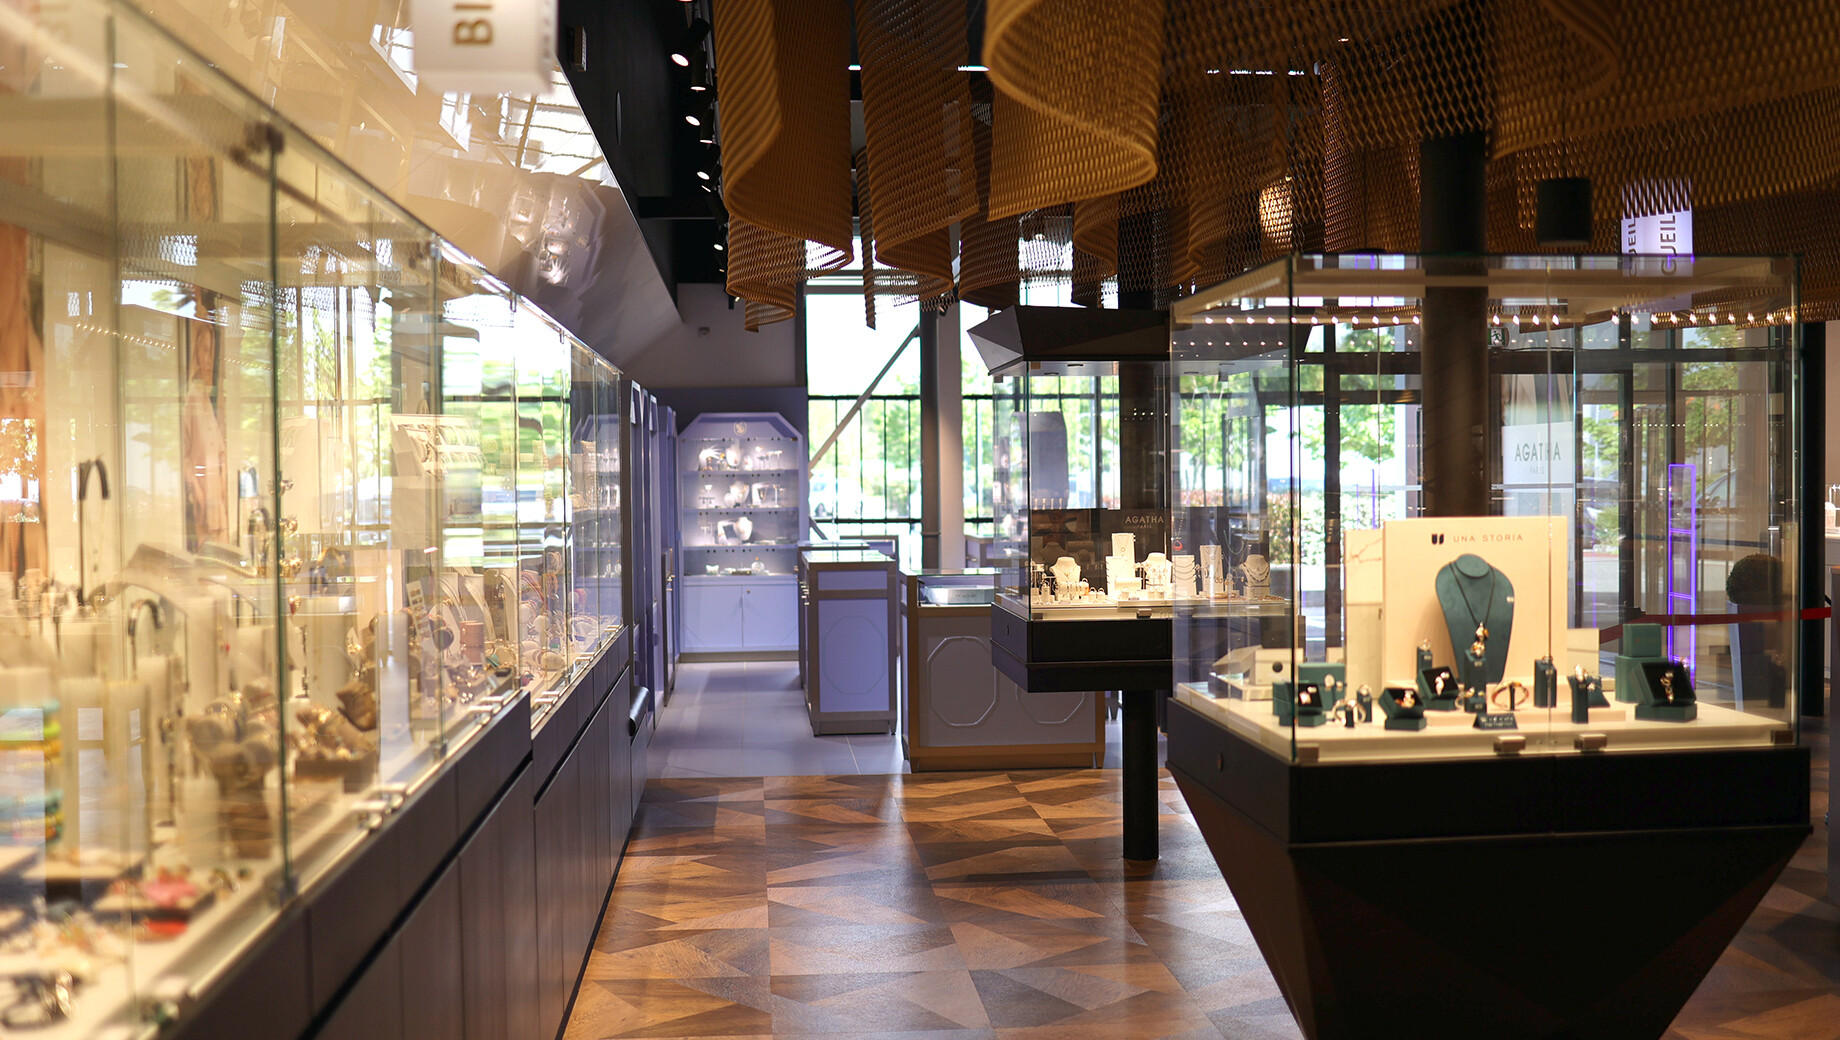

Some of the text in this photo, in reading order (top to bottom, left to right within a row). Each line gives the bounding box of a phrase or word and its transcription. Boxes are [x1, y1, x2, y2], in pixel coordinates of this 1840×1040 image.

[1125, 515, 1164, 524] AGATHA
[1453, 533, 1524, 543] UNA STORIA
